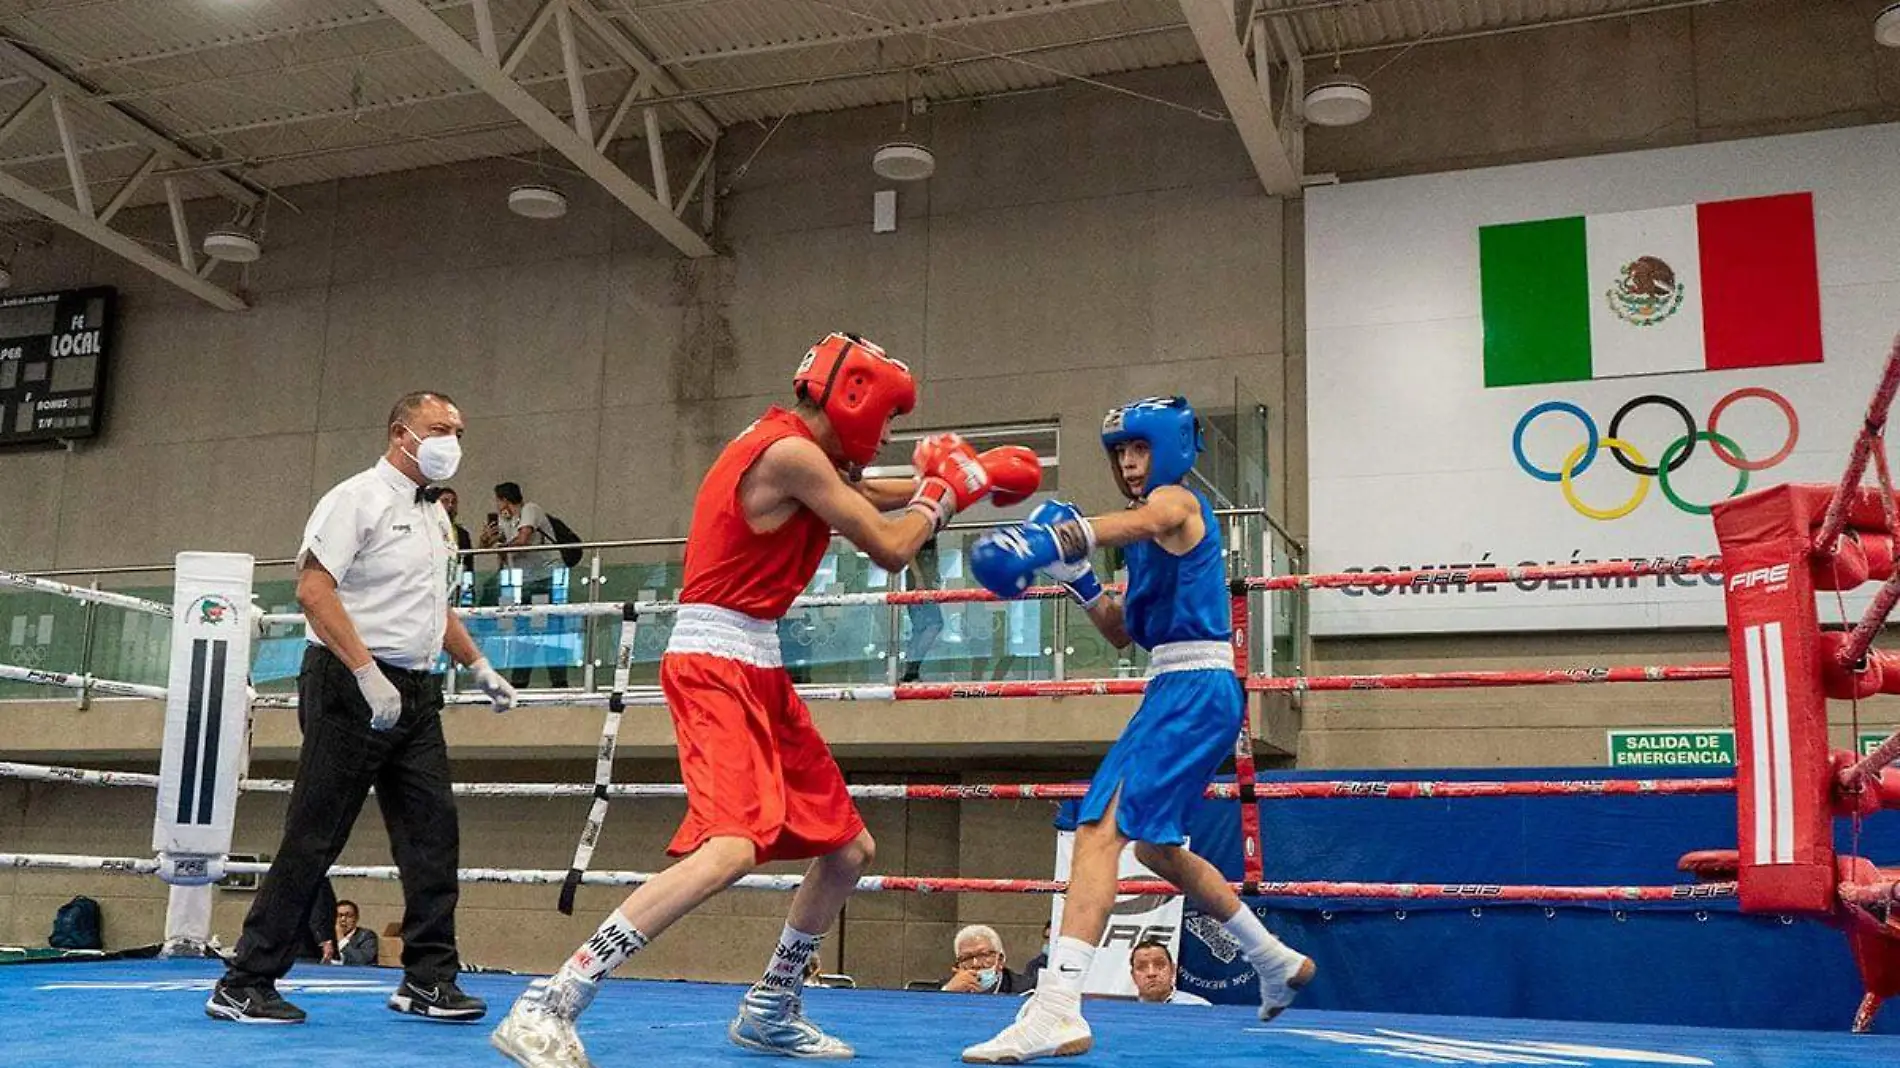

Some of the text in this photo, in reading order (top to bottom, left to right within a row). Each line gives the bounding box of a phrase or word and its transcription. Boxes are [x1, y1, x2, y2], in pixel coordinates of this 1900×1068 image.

[50, 330, 100, 357] LOCAL
[1340, 551, 1497, 597] COMITÉ
[1729, 563, 1790, 592] FIRE
[1626, 735, 1720, 749] SALIDA DE
[1617, 751, 1731, 765] EMERGENCIA
[1103, 925, 1176, 948] RE
